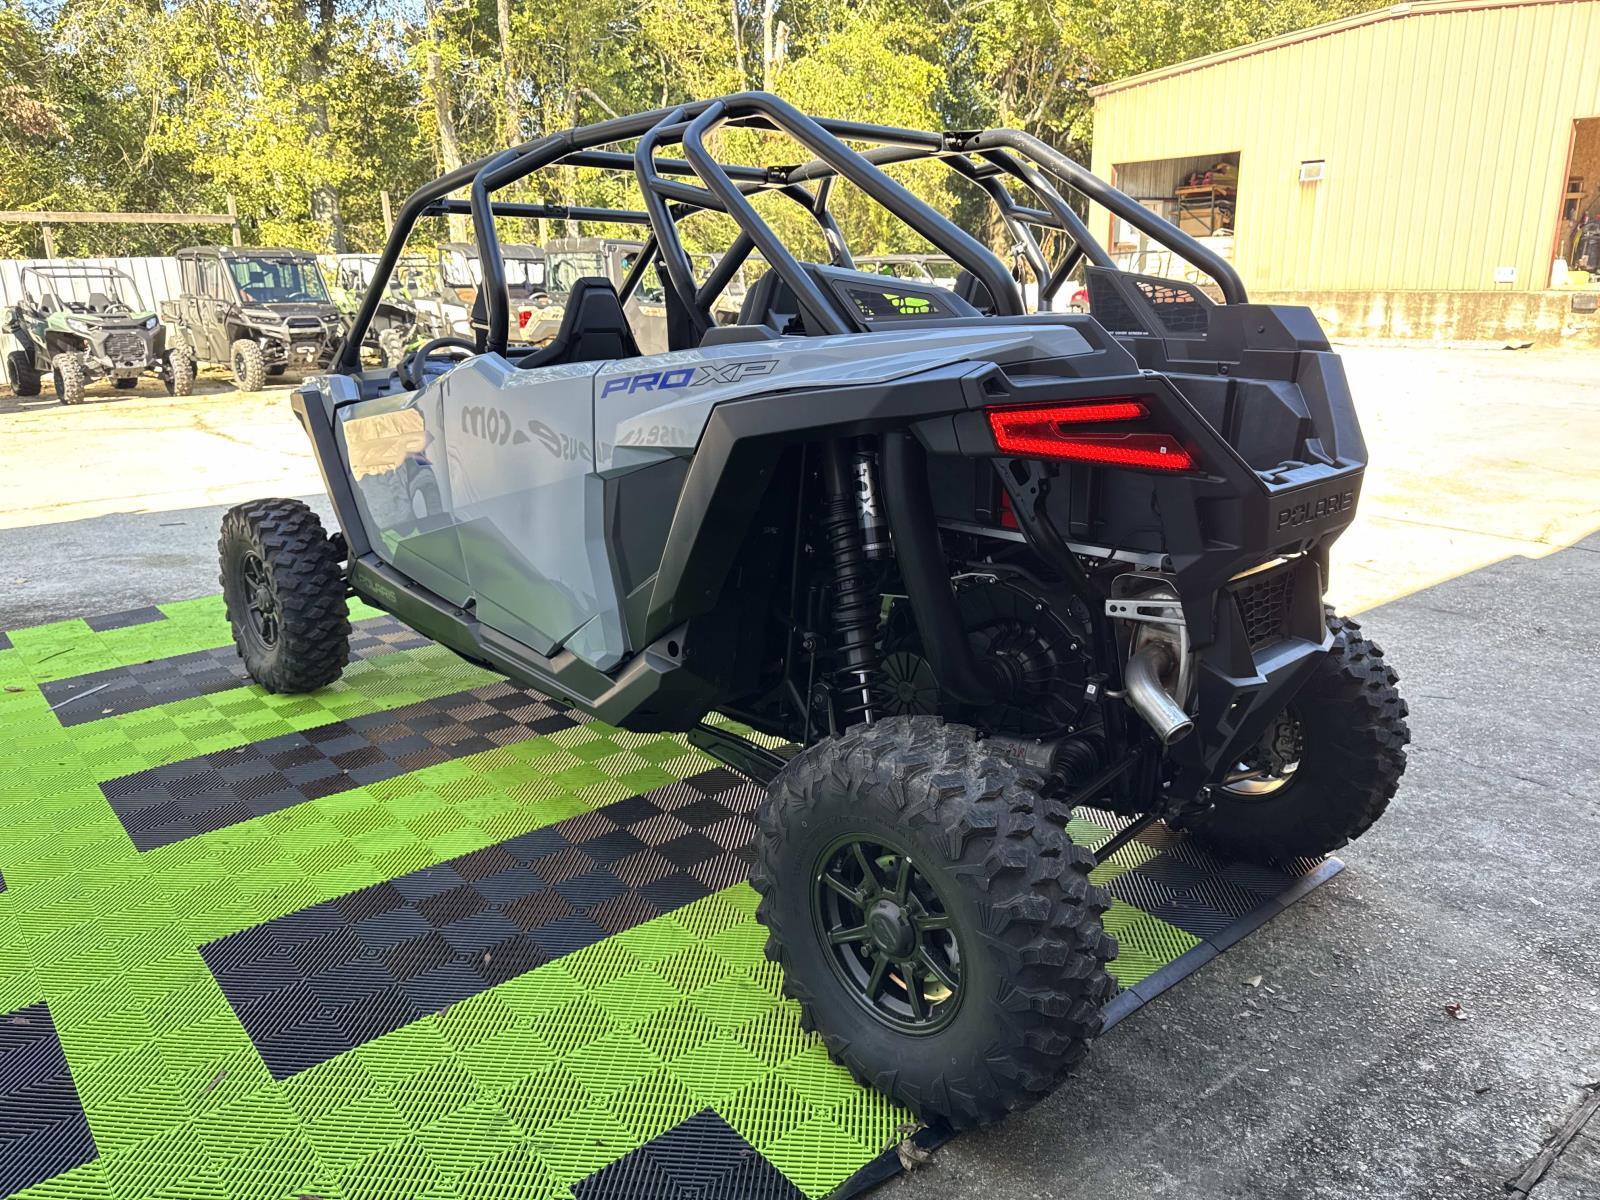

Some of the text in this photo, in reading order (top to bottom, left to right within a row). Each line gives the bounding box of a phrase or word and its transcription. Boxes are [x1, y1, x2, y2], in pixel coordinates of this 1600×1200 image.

[600, 359, 780, 399] PRO XP
[1276, 489, 1354, 532] POLARIS
